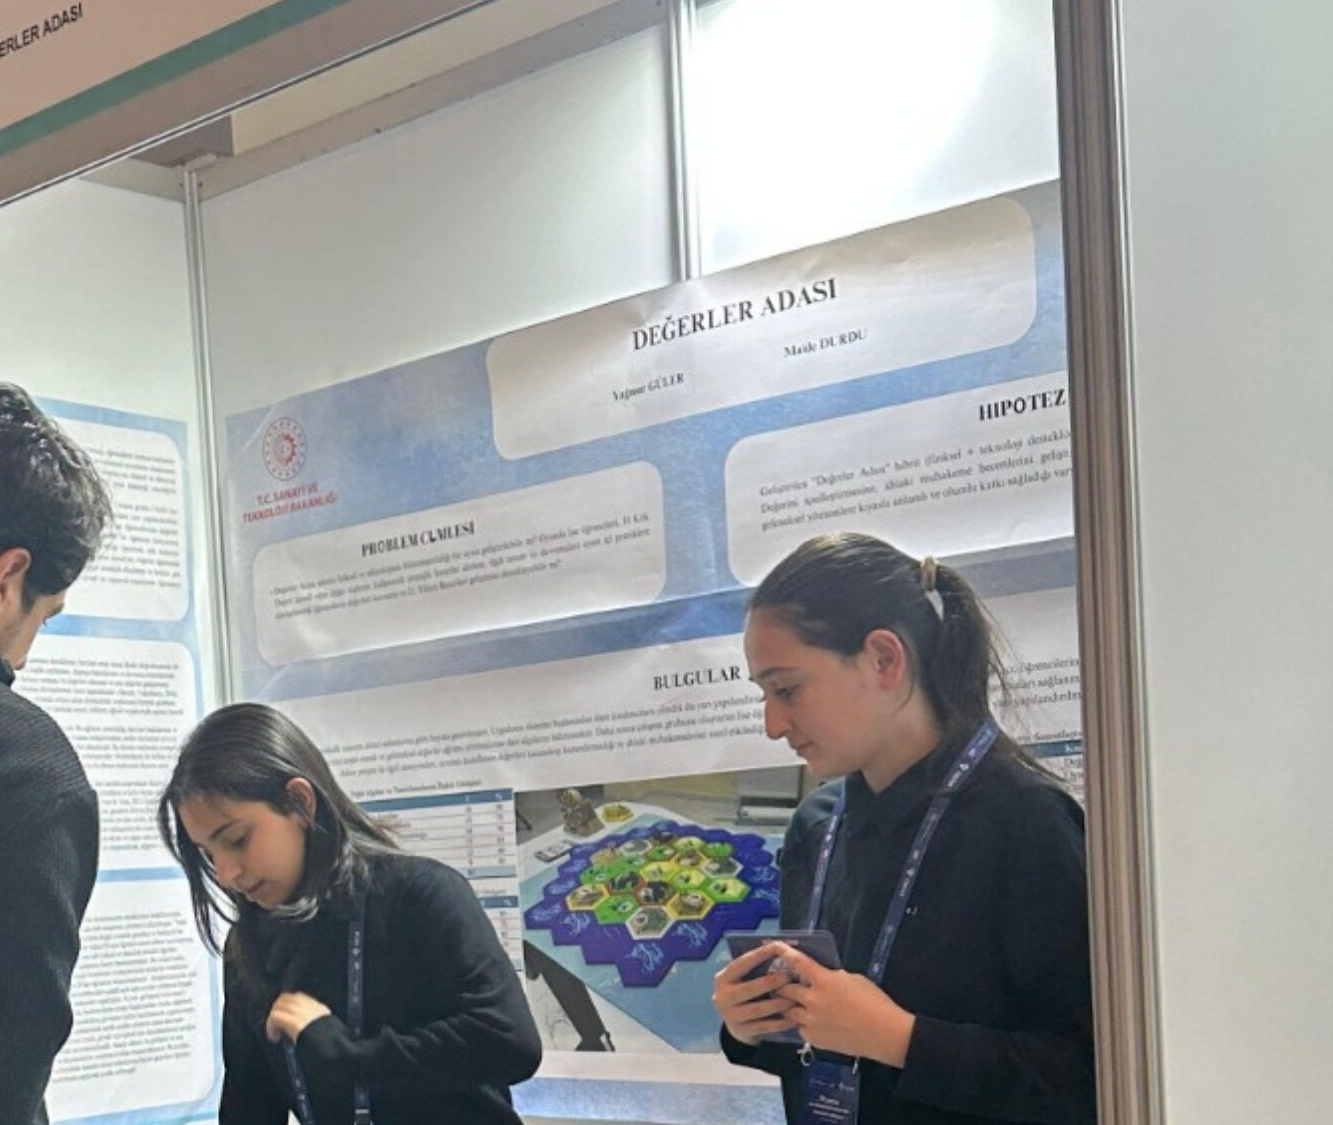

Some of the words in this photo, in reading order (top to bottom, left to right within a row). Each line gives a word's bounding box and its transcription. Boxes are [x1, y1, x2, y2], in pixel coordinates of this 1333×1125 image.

[42, 2, 84, 43] ADASI
[632, 300, 753, 351] DEĞERLER
[760, 278, 838, 317] ADASI
[361, 532, 418, 557] PROBLEM
[653, 666, 742, 692] BULGULAR
